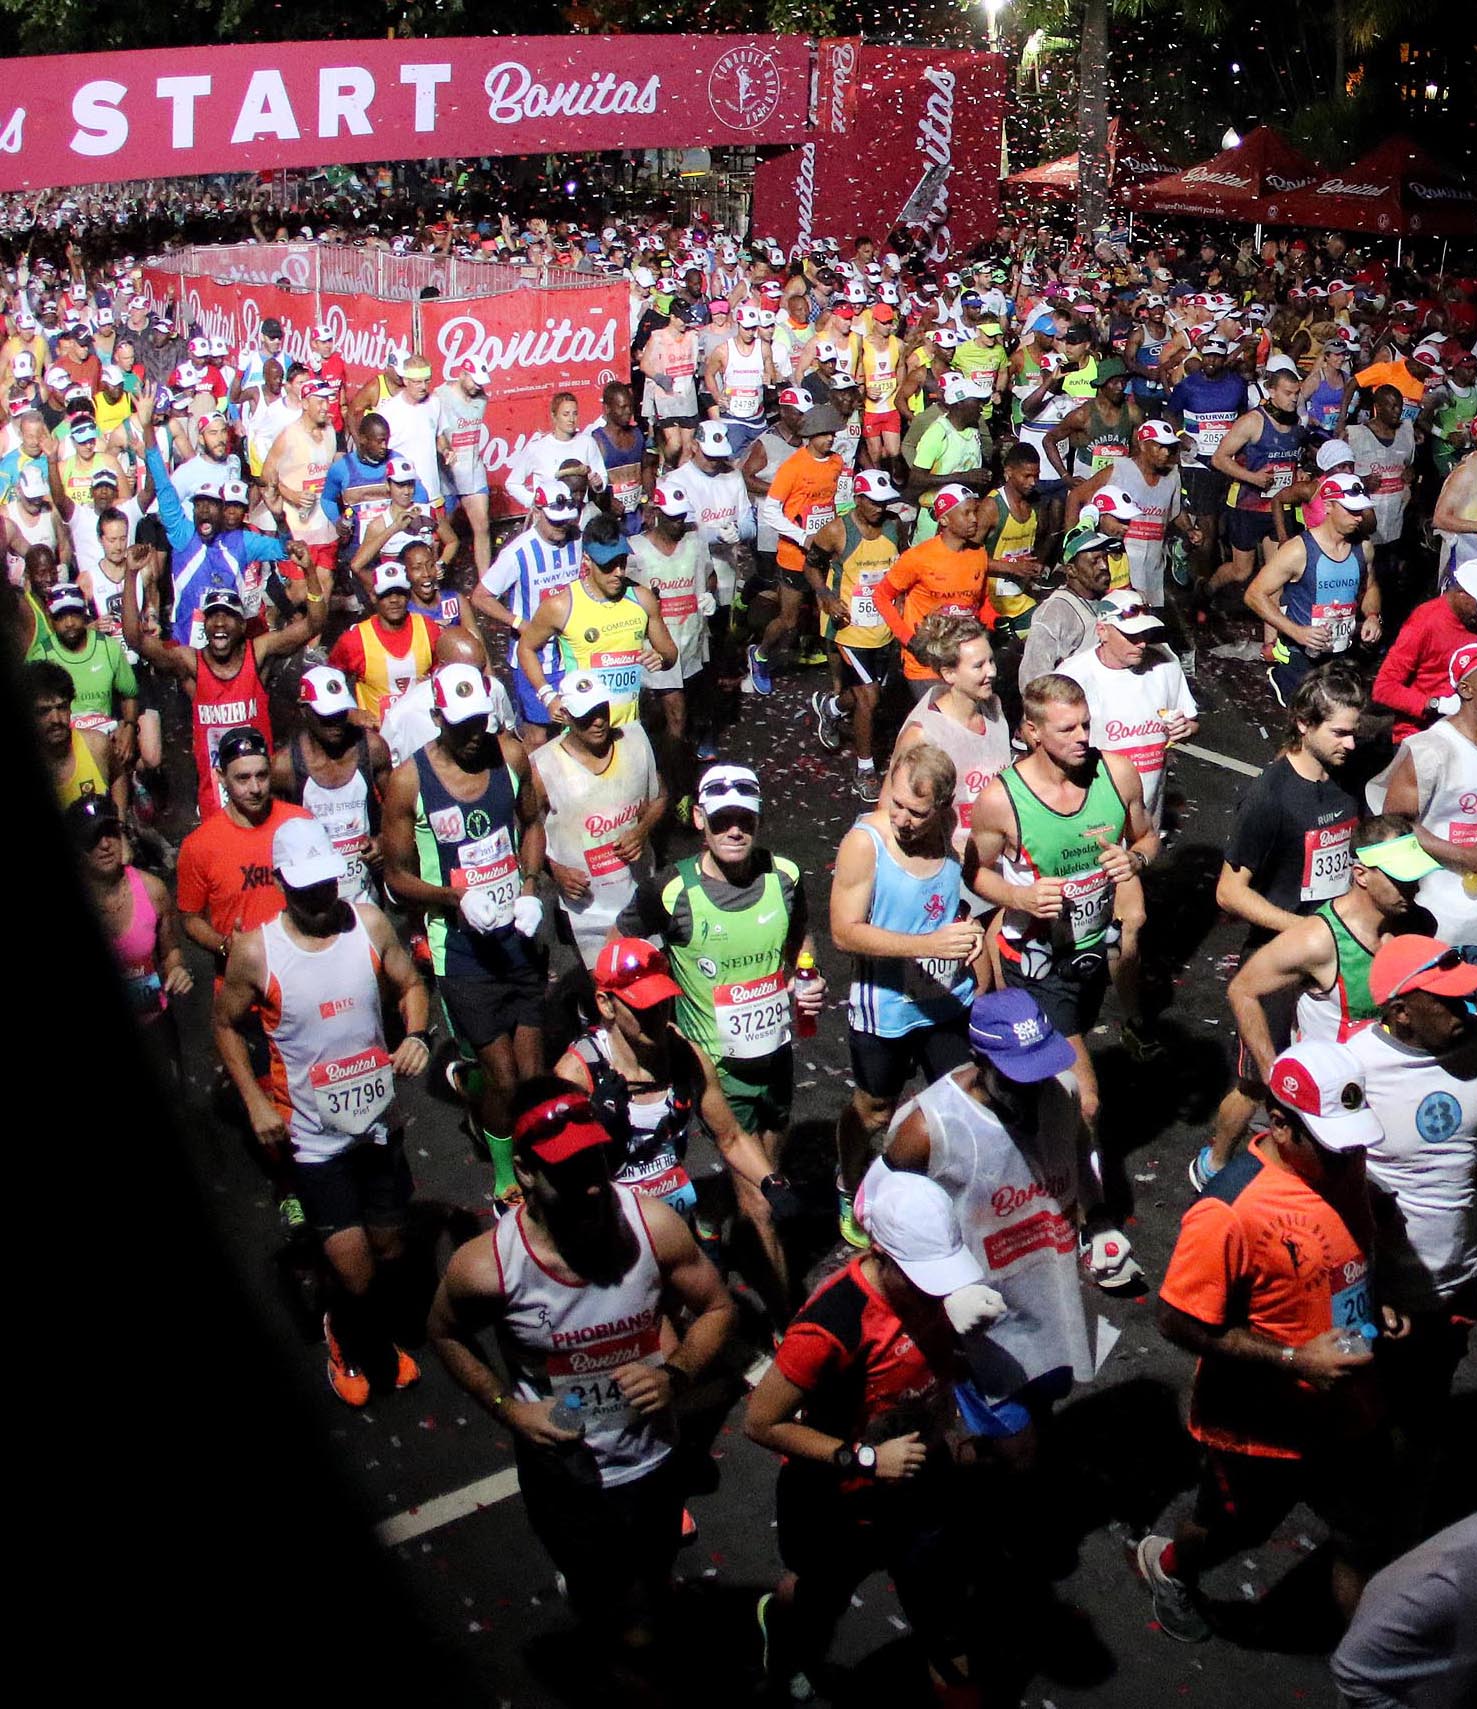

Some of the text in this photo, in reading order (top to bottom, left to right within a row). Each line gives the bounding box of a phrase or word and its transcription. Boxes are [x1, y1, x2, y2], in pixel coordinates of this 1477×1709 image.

[484, 61, 661, 125] Bonitas
[70, 63, 452, 157] START
[905, 65, 956, 263] Boitas
[1182, 166, 1251, 190] Bonitas
[1316, 178, 1389, 199] Bonitas
[242, 299, 313, 366] Bitas
[326, 305, 410, 370] Bonitas
[437, 315, 618, 383] Bonitas
[443, 598, 457, 617] 40
[600, 617, 642, 634] COMRADES
[601, 654, 635, 668] Bonitas
[74, 715, 107, 729] Bonitas
[198, 706, 247, 726] EBENEZER
[335, 800, 366, 812] STRIDER
[464, 864, 509, 885] Bonitas
[729, 980, 778, 1003] Bonitas
[729, 1002, 784, 1035] 37229
[1012, 1018, 1037, 1035] SOUL
[744, 1027, 777, 1043] Wessel
[1018, 1026, 1040, 1041] CITY
[325, 1057, 378, 1081] Bonitas
[327, 1078, 386, 1114] 37796
[551, 1311, 654, 1350] PHOBIANS
[572, 1345, 641, 1373] Bonitas
